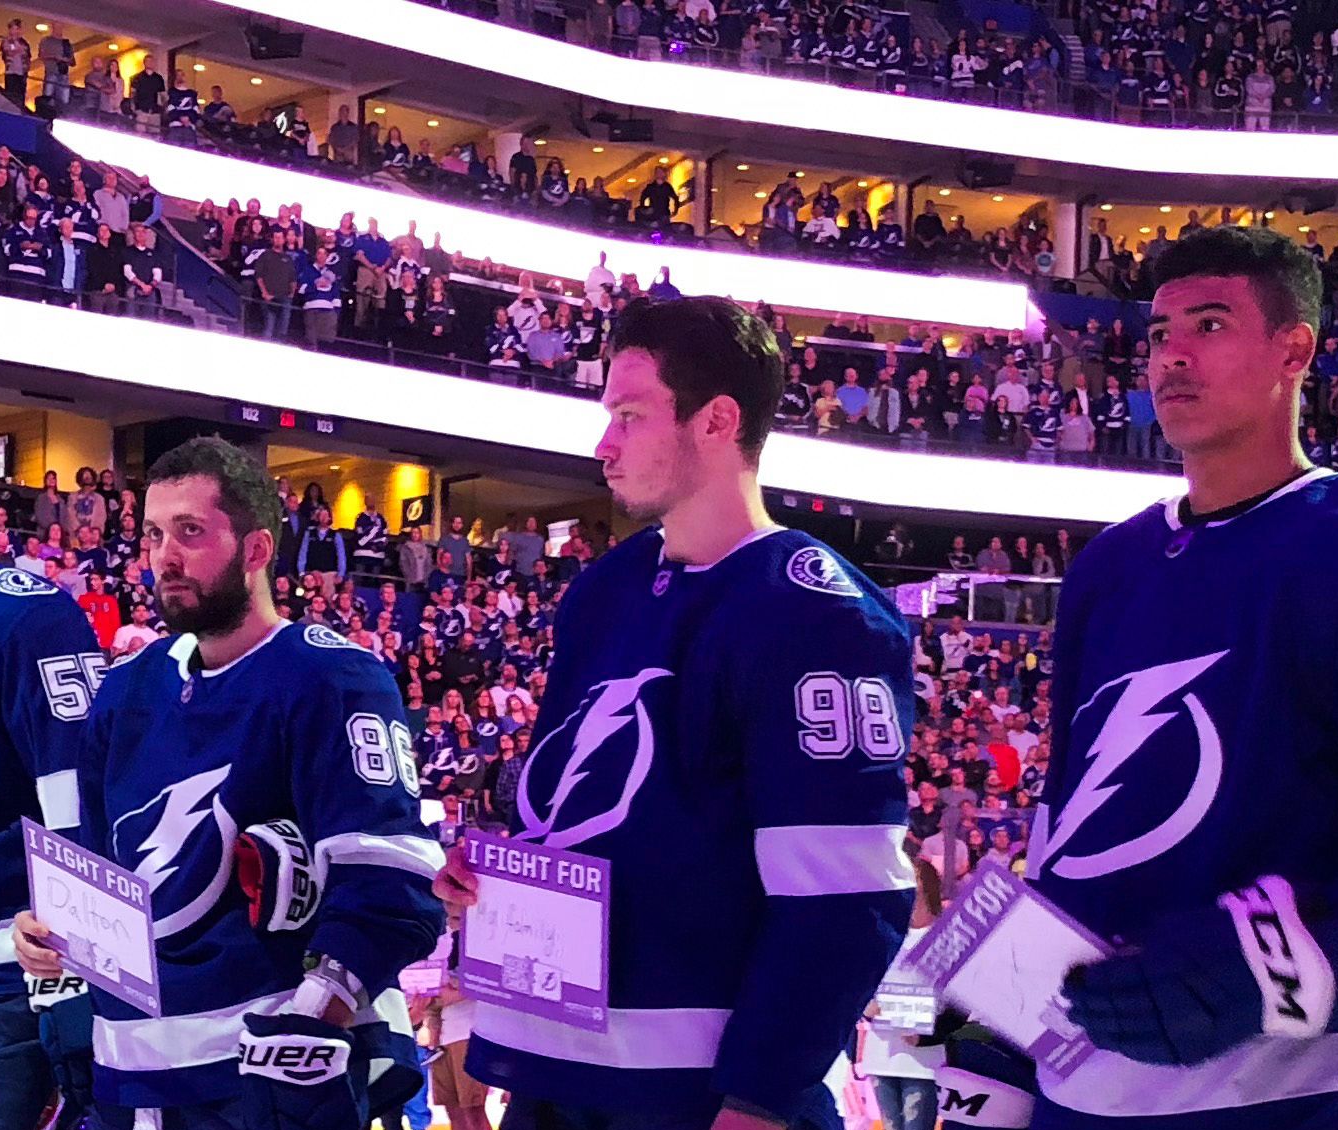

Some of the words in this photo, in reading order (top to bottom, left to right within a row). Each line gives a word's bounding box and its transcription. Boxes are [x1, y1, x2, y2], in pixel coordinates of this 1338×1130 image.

[793, 670, 906, 760] 98
[346, 712, 422, 799] 86
[27, 827, 39, 851] I
[42, 835, 101, 883] FIGHT
[105, 869, 145, 907] FOR
[468, 839, 481, 866] I
[484, 843, 552, 882] FIGHT
[557, 859, 603, 894] FOR
[46, 875, 132, 943] Dalton
